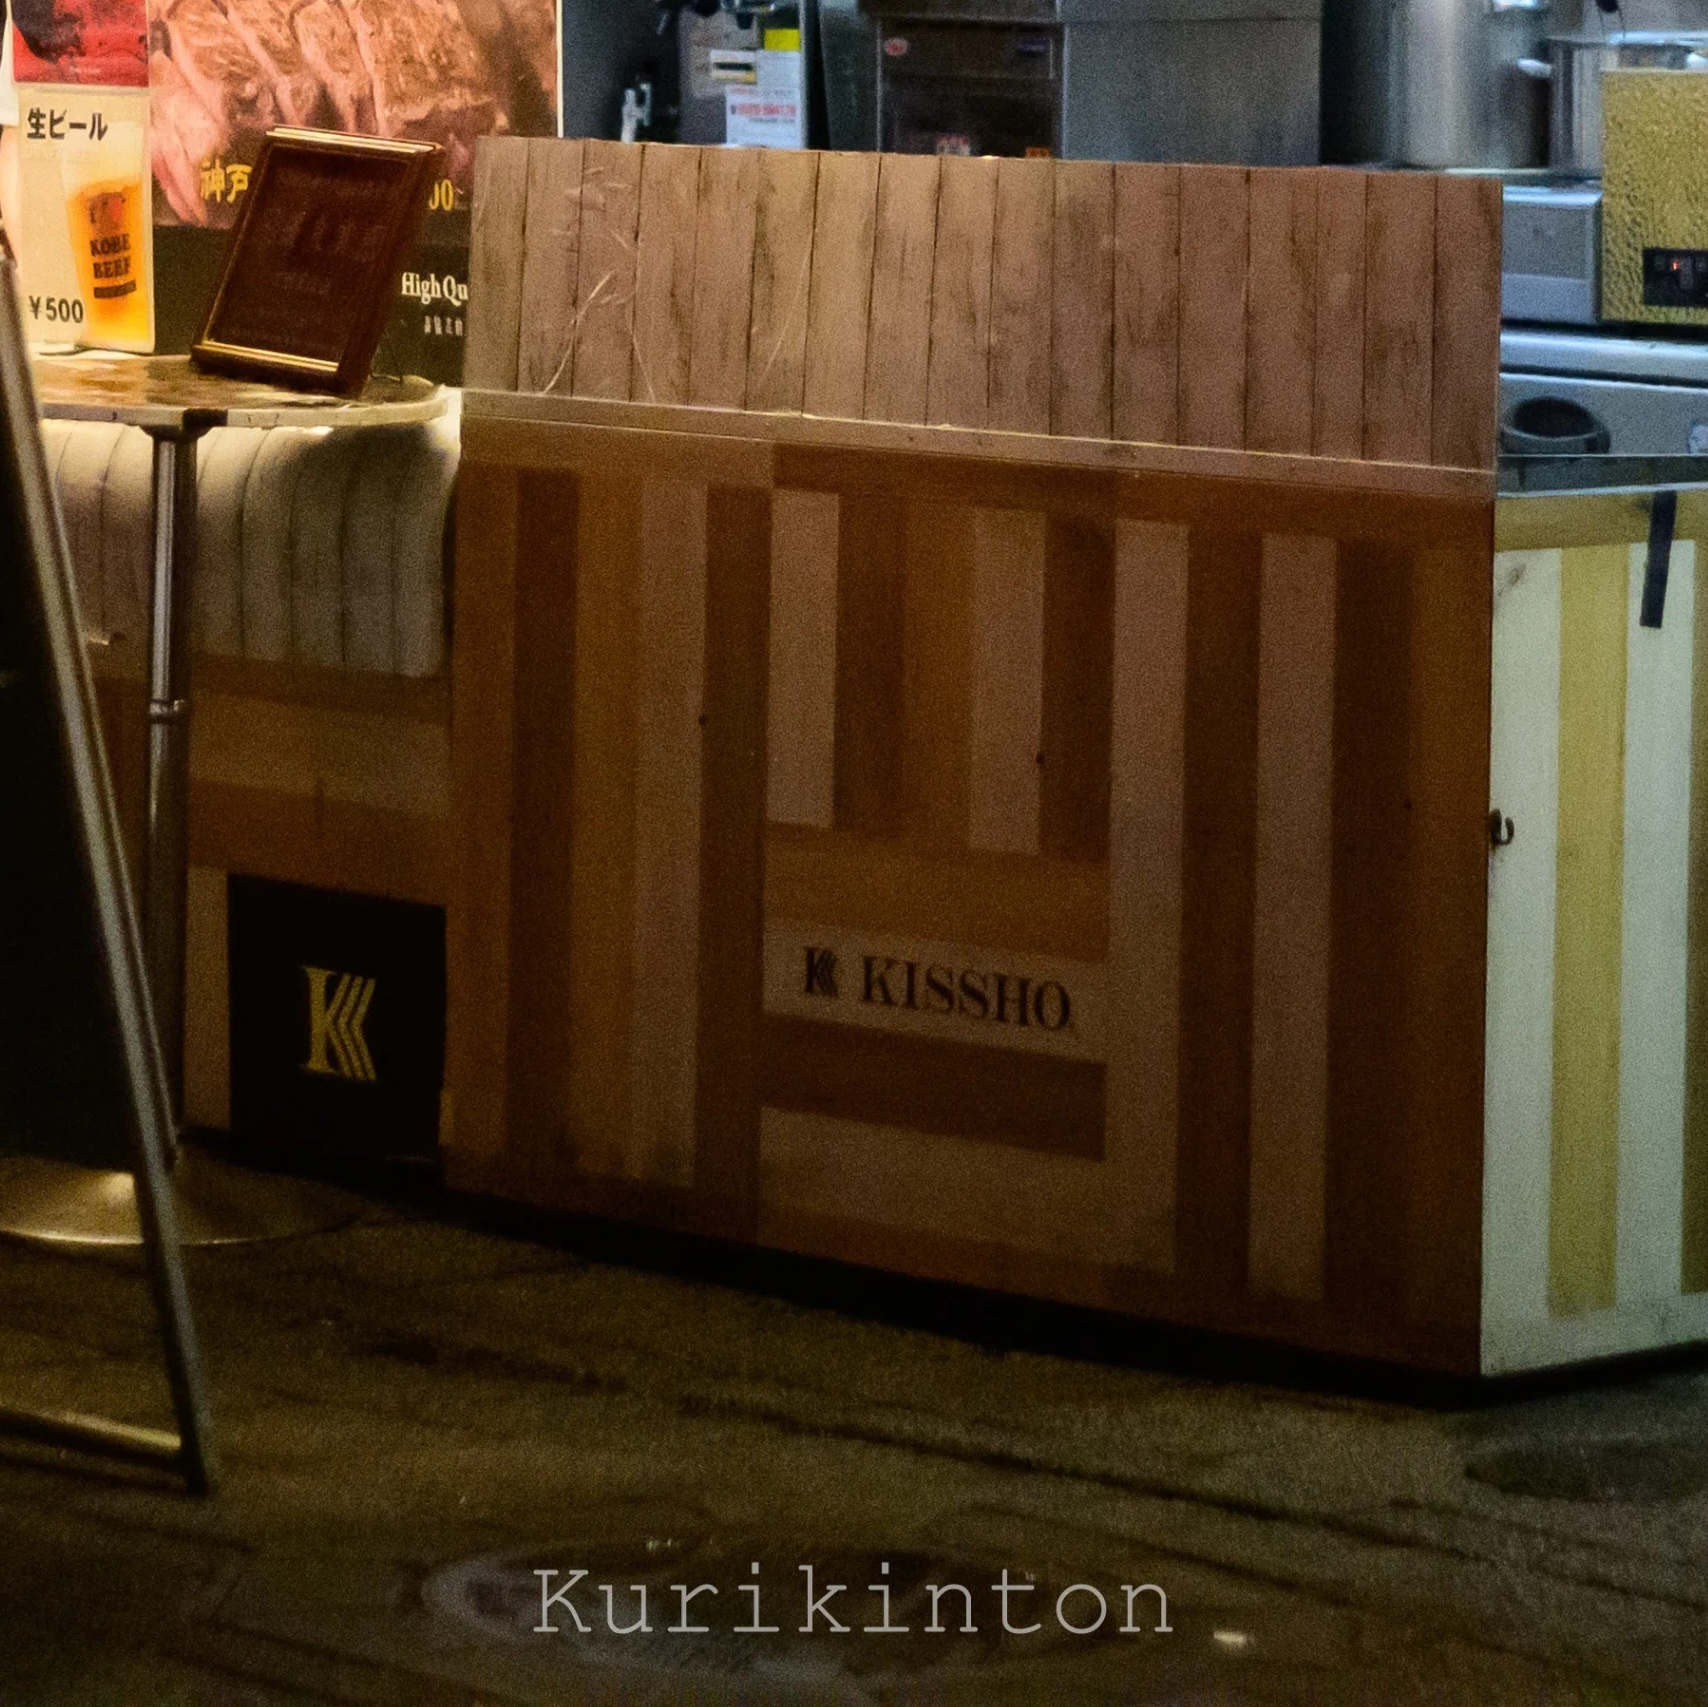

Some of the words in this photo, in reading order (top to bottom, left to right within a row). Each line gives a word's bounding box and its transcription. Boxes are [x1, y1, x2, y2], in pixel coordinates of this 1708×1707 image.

[27, 107, 108, 141] 生ビール
[90, 234, 131, 256] KOBE
[93, 258, 130, 280] BEEF
[401, 272, 442, 305] High
[29, 295, 84, 323] ¥500
[861, 954, 1071, 1032] KISSHO
